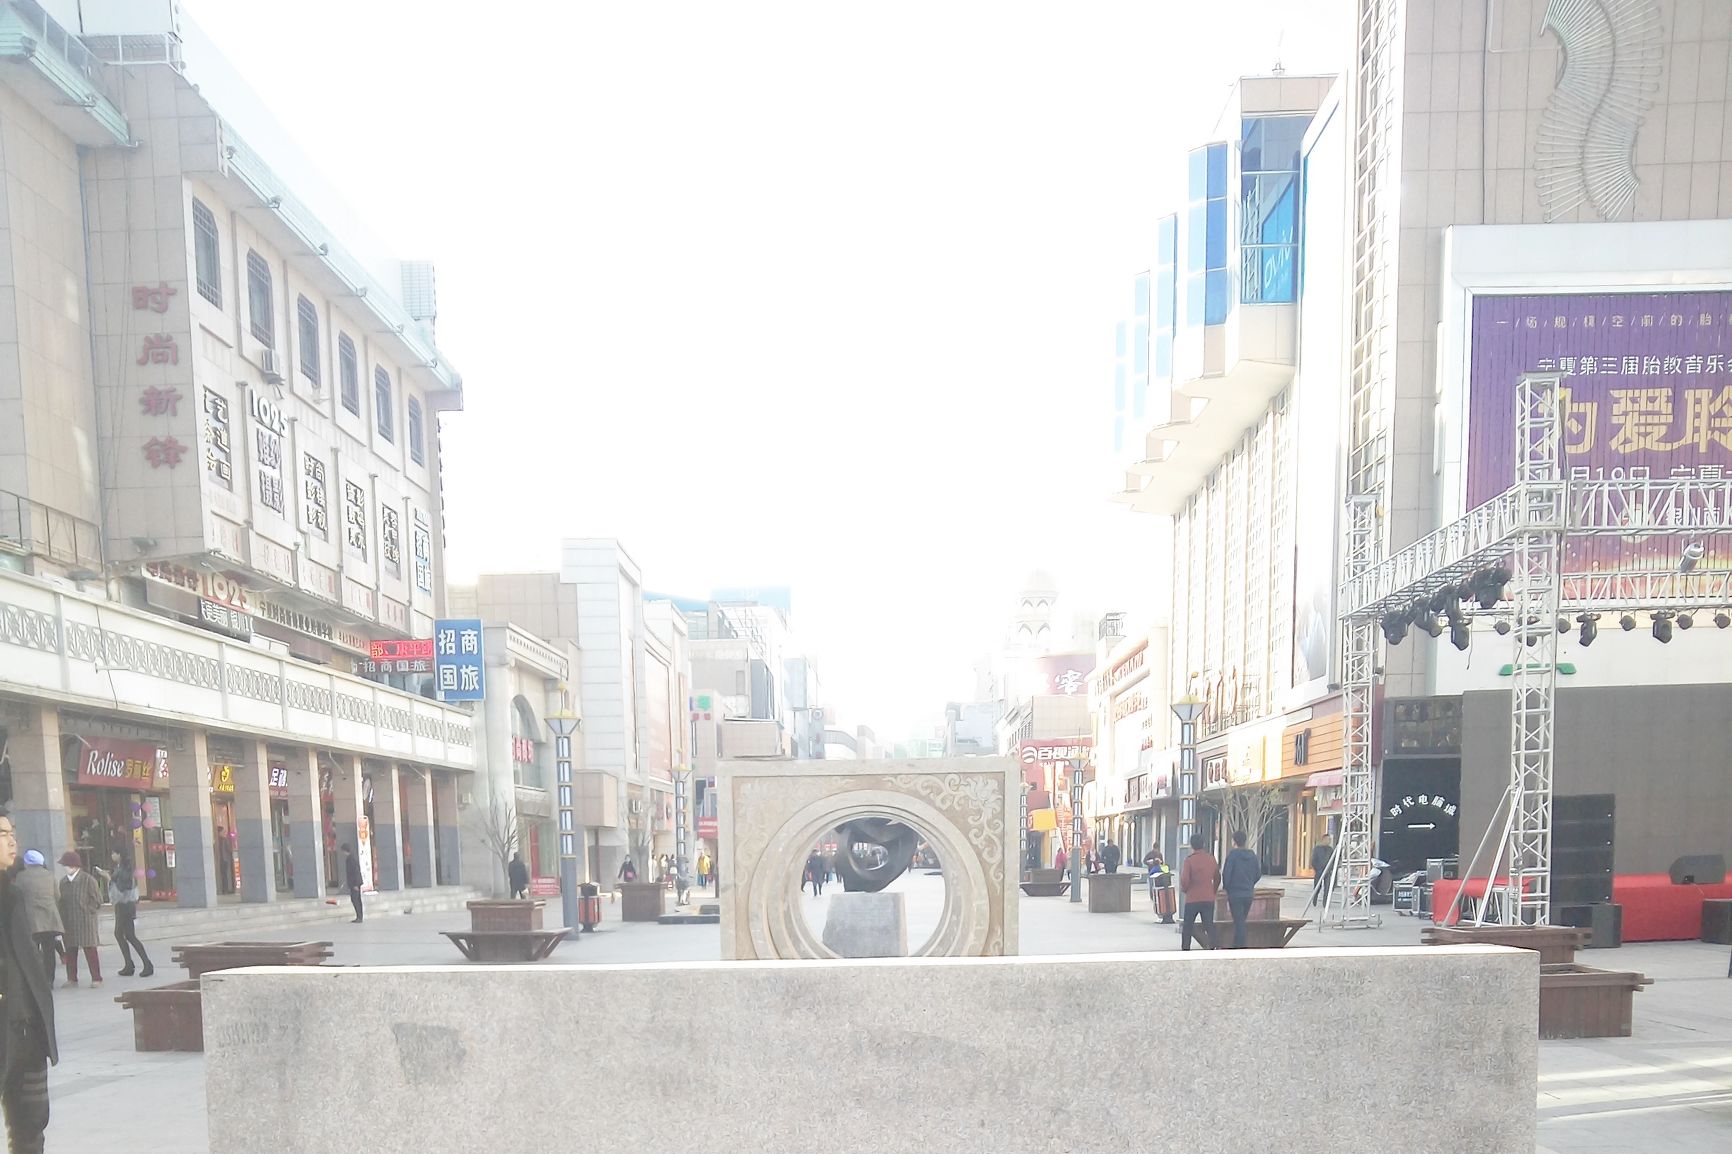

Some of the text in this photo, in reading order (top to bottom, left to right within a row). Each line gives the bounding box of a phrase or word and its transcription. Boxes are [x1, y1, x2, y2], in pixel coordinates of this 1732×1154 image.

[250, 388, 289, 438] 1025
[438, 629, 479, 656] 招商
[439, 664, 480, 691] 国旅
[86, 749, 125, 778] Rolise
[1389, 794, 1457, 817] 时代电脑城
